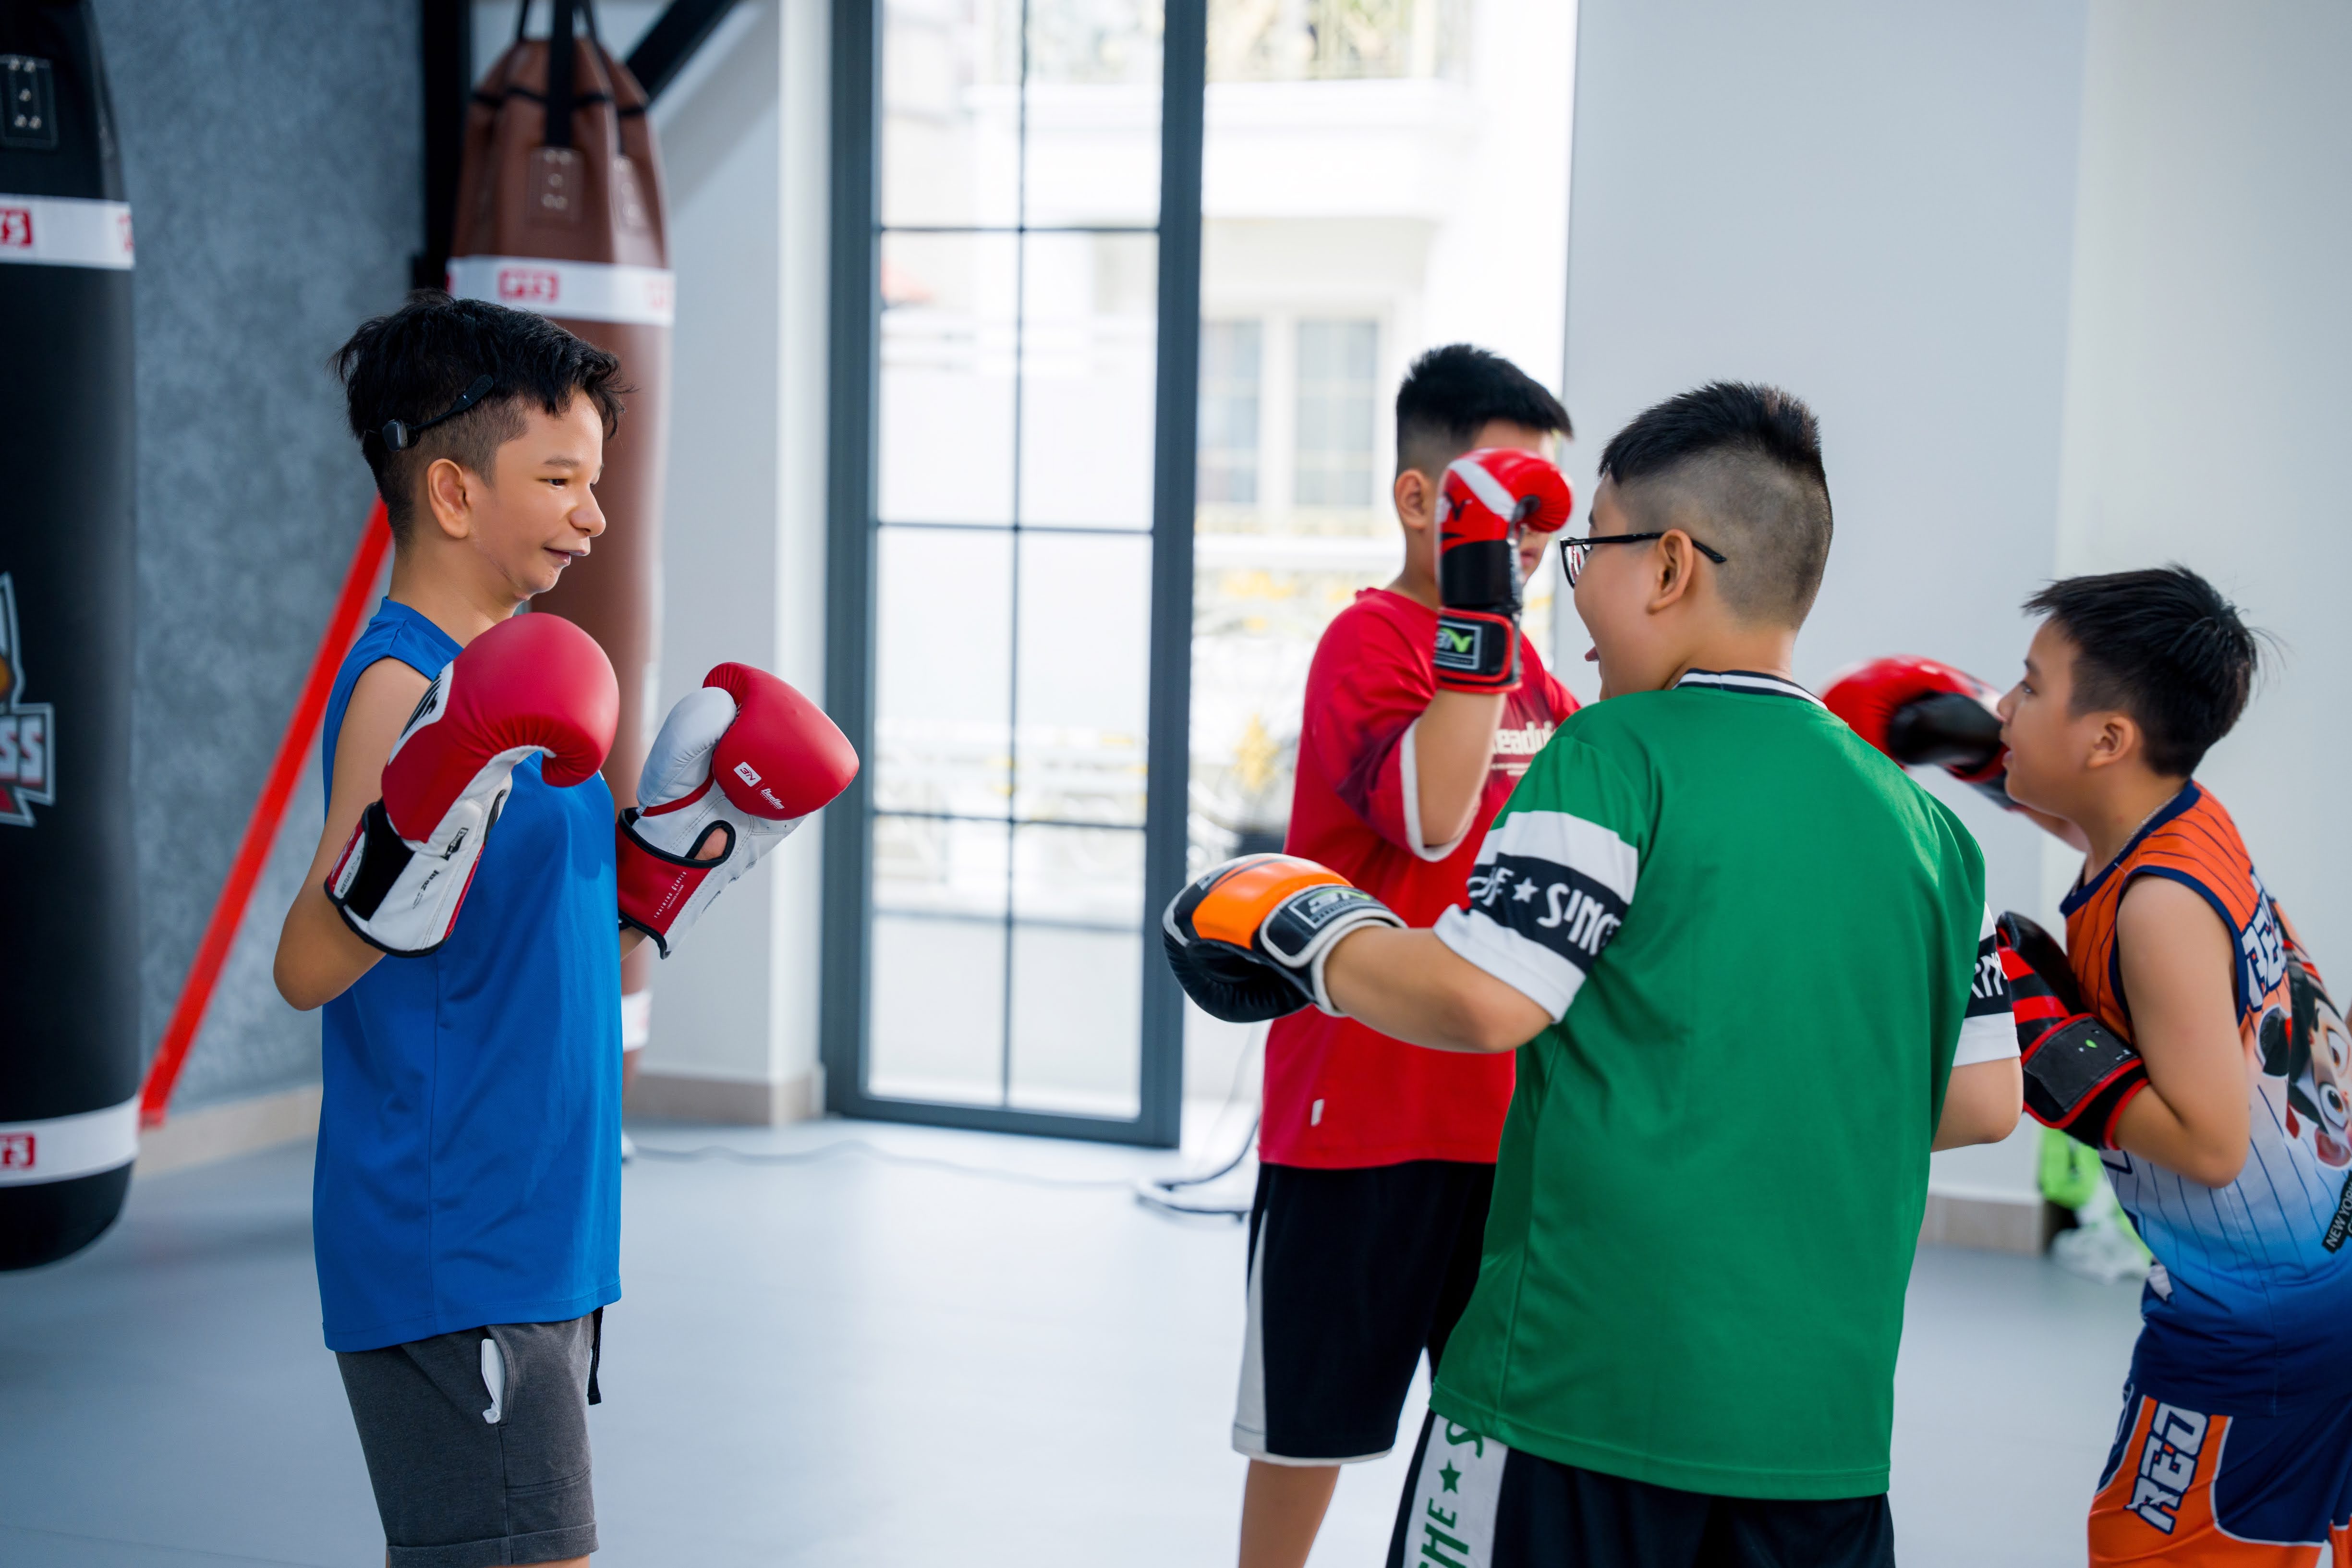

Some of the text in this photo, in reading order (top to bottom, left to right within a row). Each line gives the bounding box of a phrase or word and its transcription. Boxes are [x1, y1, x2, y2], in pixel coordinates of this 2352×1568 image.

[654, 892, 672, 918] TRAINING
[2326, 1215, 2346, 1248] NEW
[2125, 1401, 2209, 1533] RED
[1418, 1497, 1469, 1568] HE
